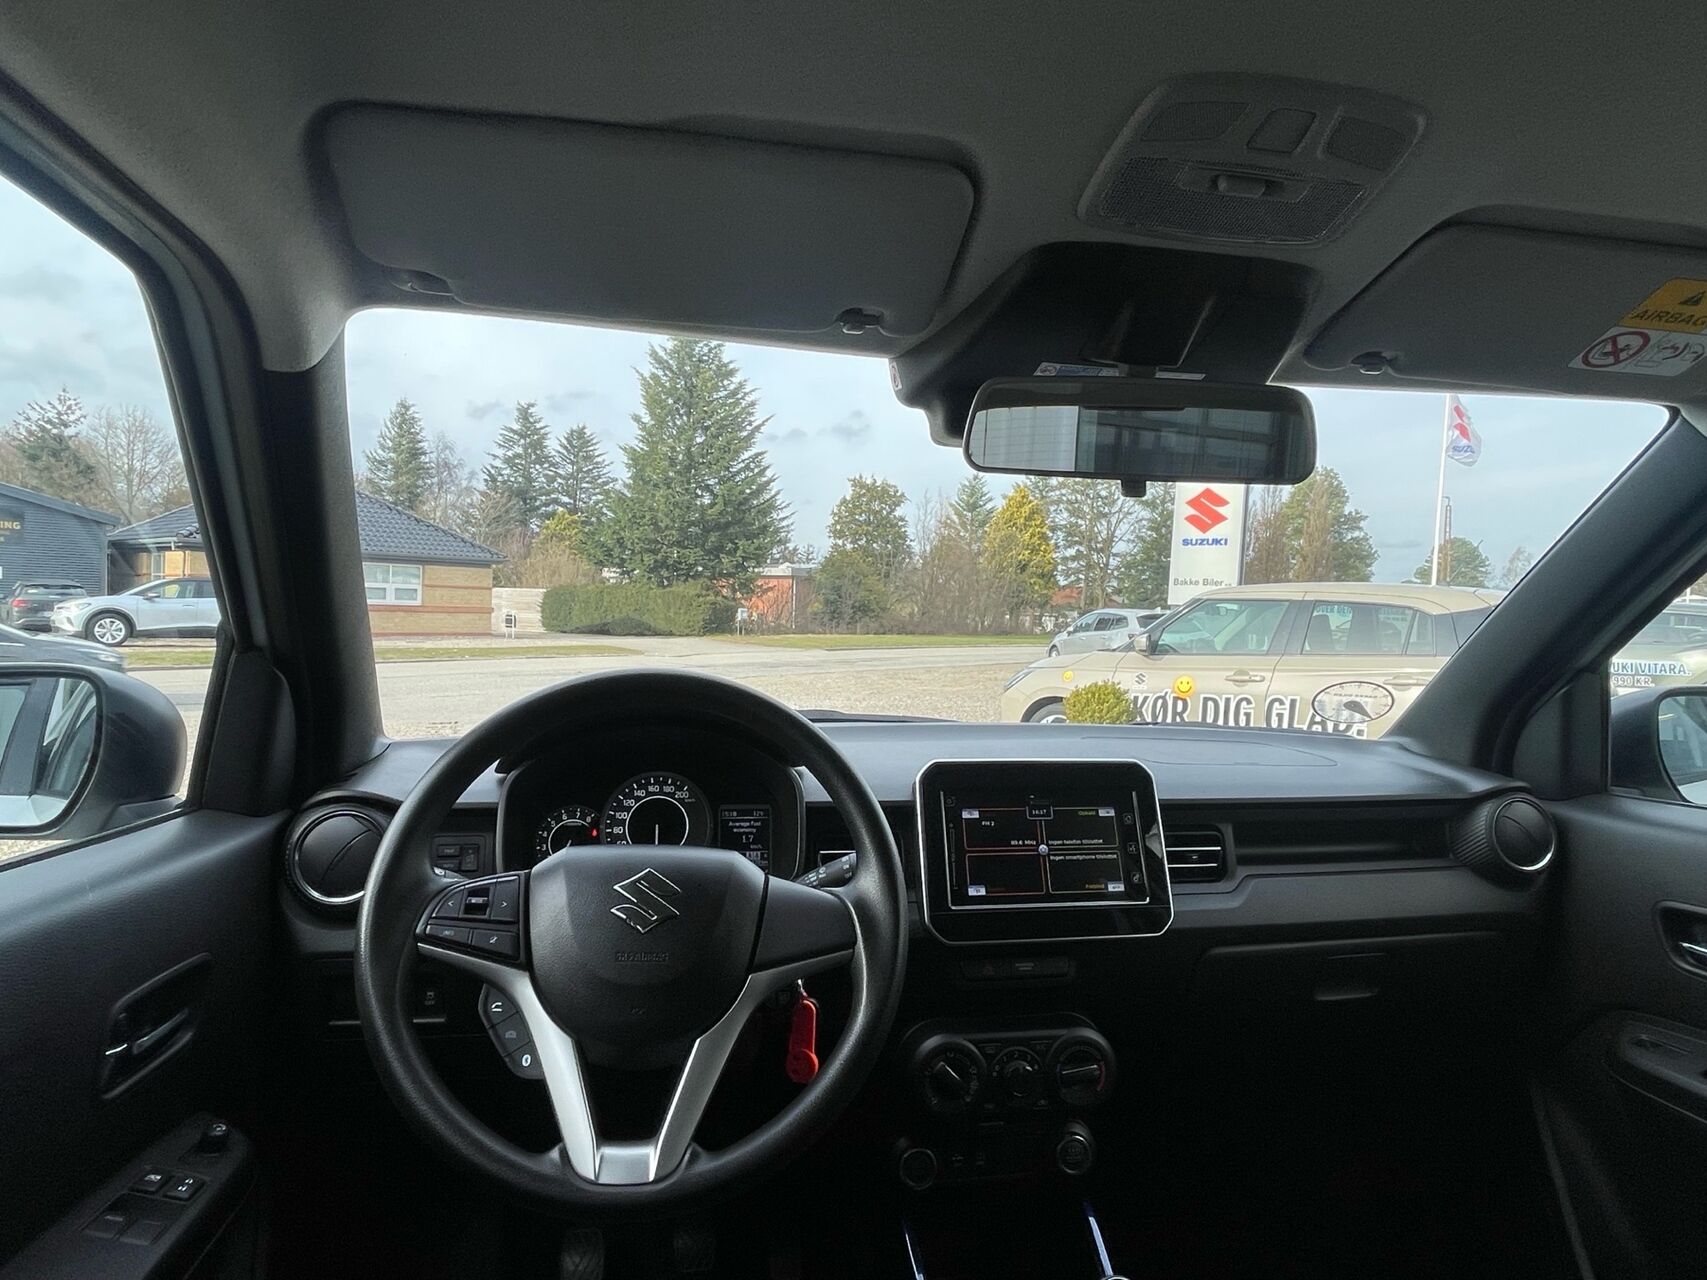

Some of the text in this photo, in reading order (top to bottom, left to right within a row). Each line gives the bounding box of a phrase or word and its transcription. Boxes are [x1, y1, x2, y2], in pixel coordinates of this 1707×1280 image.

[1182, 538, 1228, 546] SUZUKI
[1173, 578, 1199, 586] Bakke
[1202, 578, 1223, 586] Biler
[1132, 690, 1188, 723] KØR
[1200, 695, 1254, 727] DIG
[634, 789, 646, 797] 140
